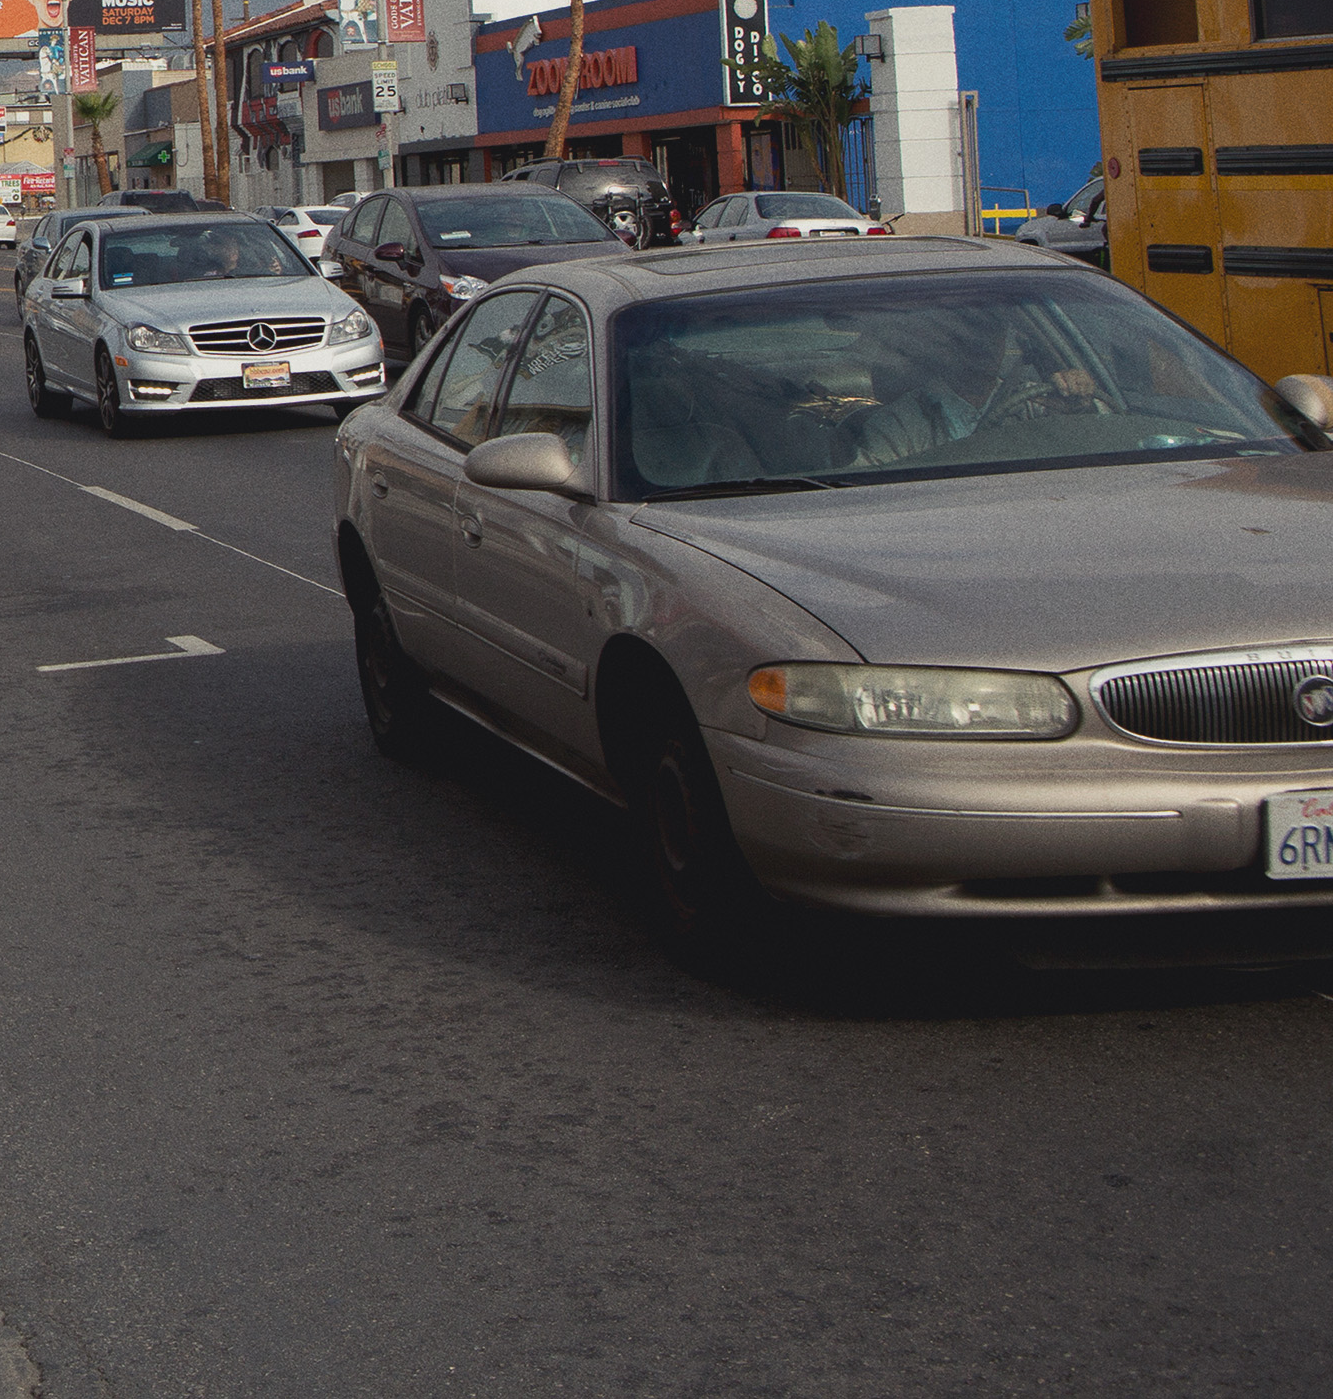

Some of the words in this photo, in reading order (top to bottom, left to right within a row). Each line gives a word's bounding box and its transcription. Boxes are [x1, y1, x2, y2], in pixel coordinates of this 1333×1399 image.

[102, 7, 154, 17] SATURDAY
[390, 4, 398, 29] GODS
[102, 16, 122, 25] DEC
[124, 16, 131, 24] 7
[134, 16, 154, 24] 8PM
[78, 30, 90, 85] VATICAN
[376, 86, 396, 98] 25
